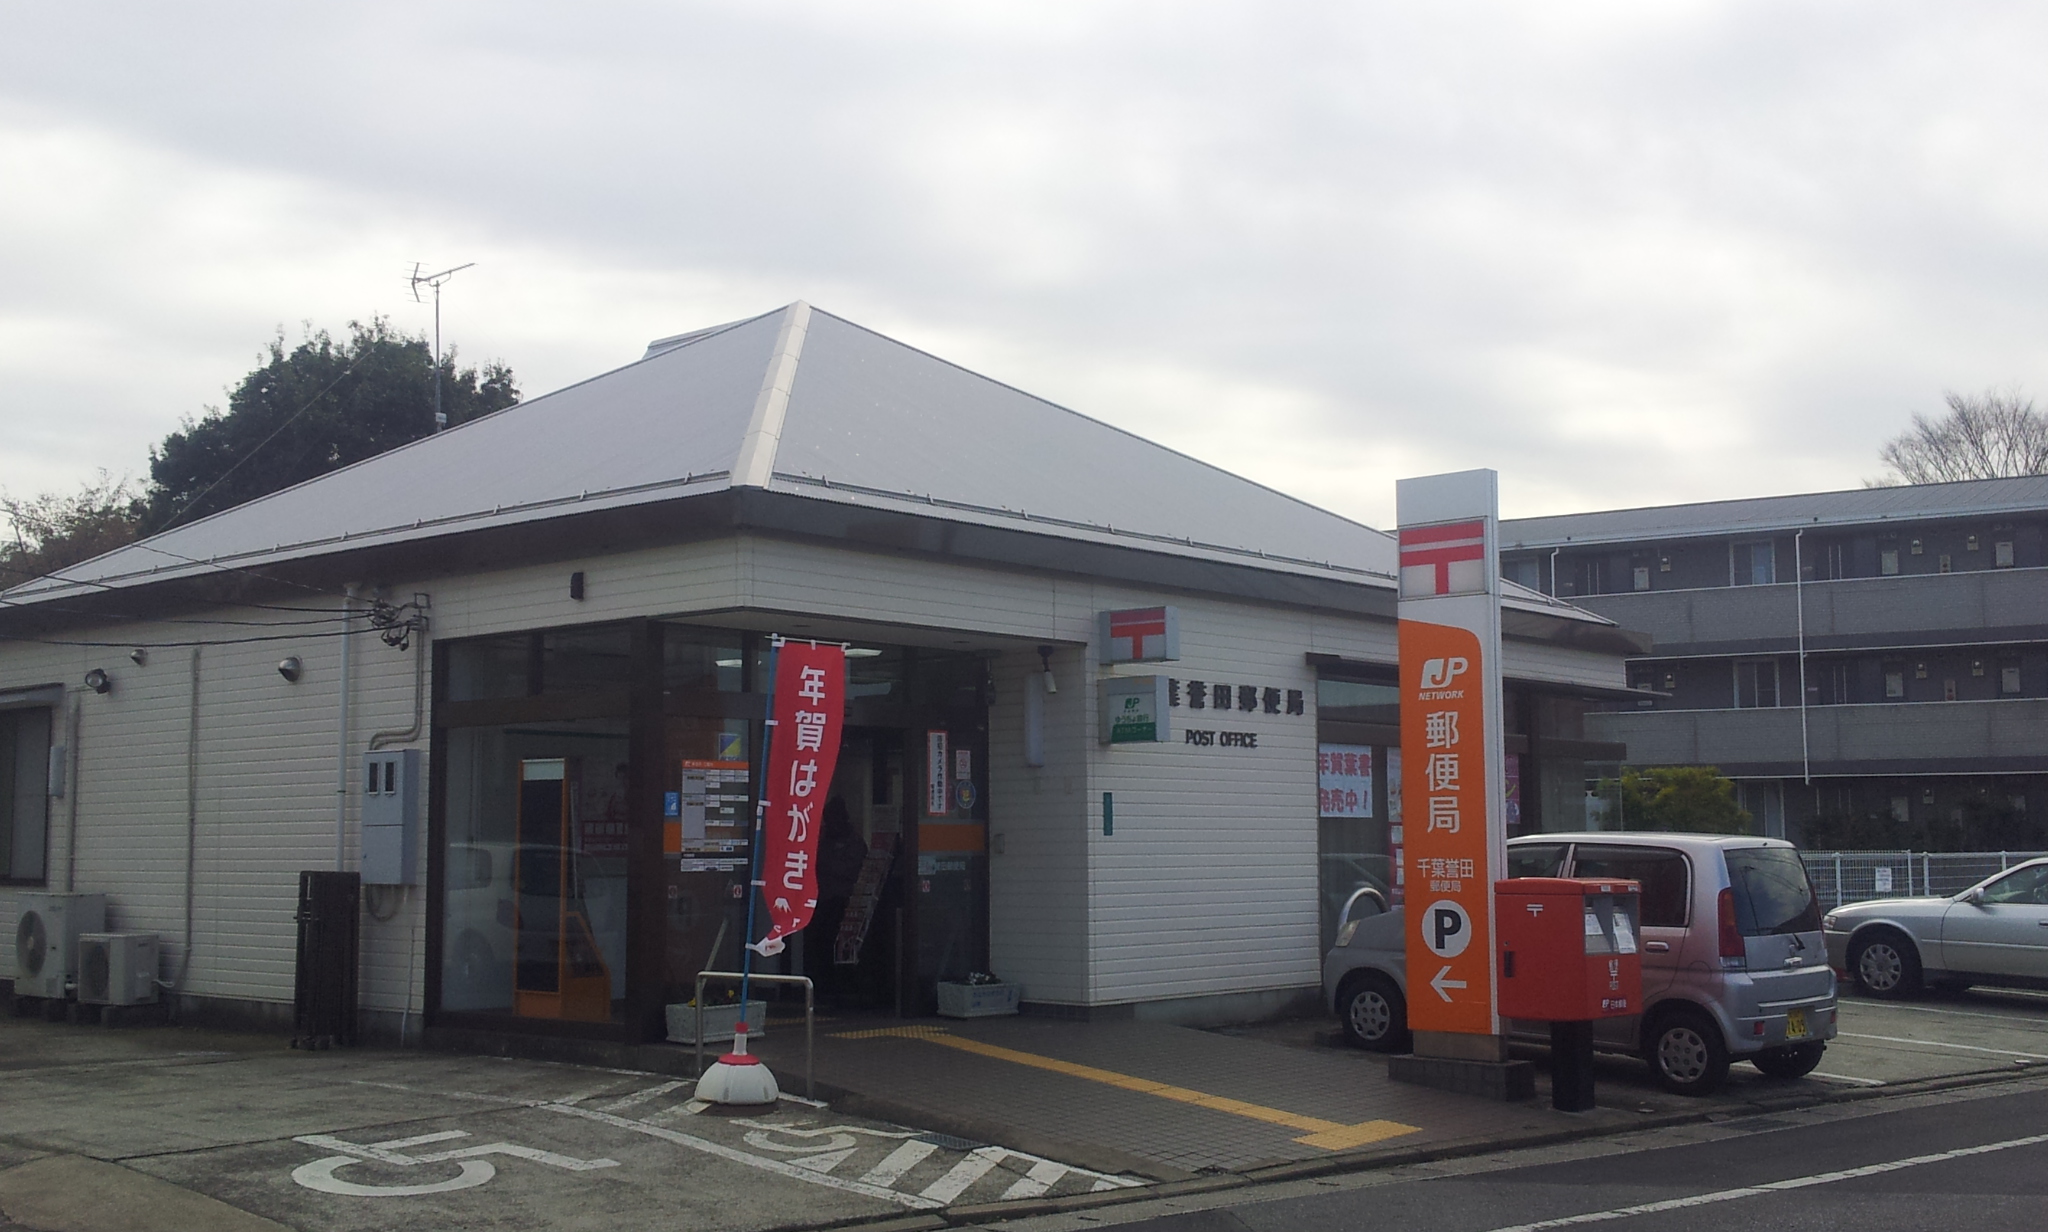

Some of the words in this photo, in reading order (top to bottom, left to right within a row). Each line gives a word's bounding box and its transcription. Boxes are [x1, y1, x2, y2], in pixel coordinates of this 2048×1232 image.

[1418, 690, 1464, 701] NETWORK
[1185, 729, 1215, 746] POST
[1220, 731, 1258, 748] OFFICE
[1319, 753, 1371, 777] 年賀葉書
[1425, 711, 1461, 834] 郵便局
[782, 665, 827, 890] 年賀はがき
[1417, 858, 1474, 878] 千葉誉田
[1430, 880, 1461, 892] 郵便局
[1434, 908, 1462, 949] P
